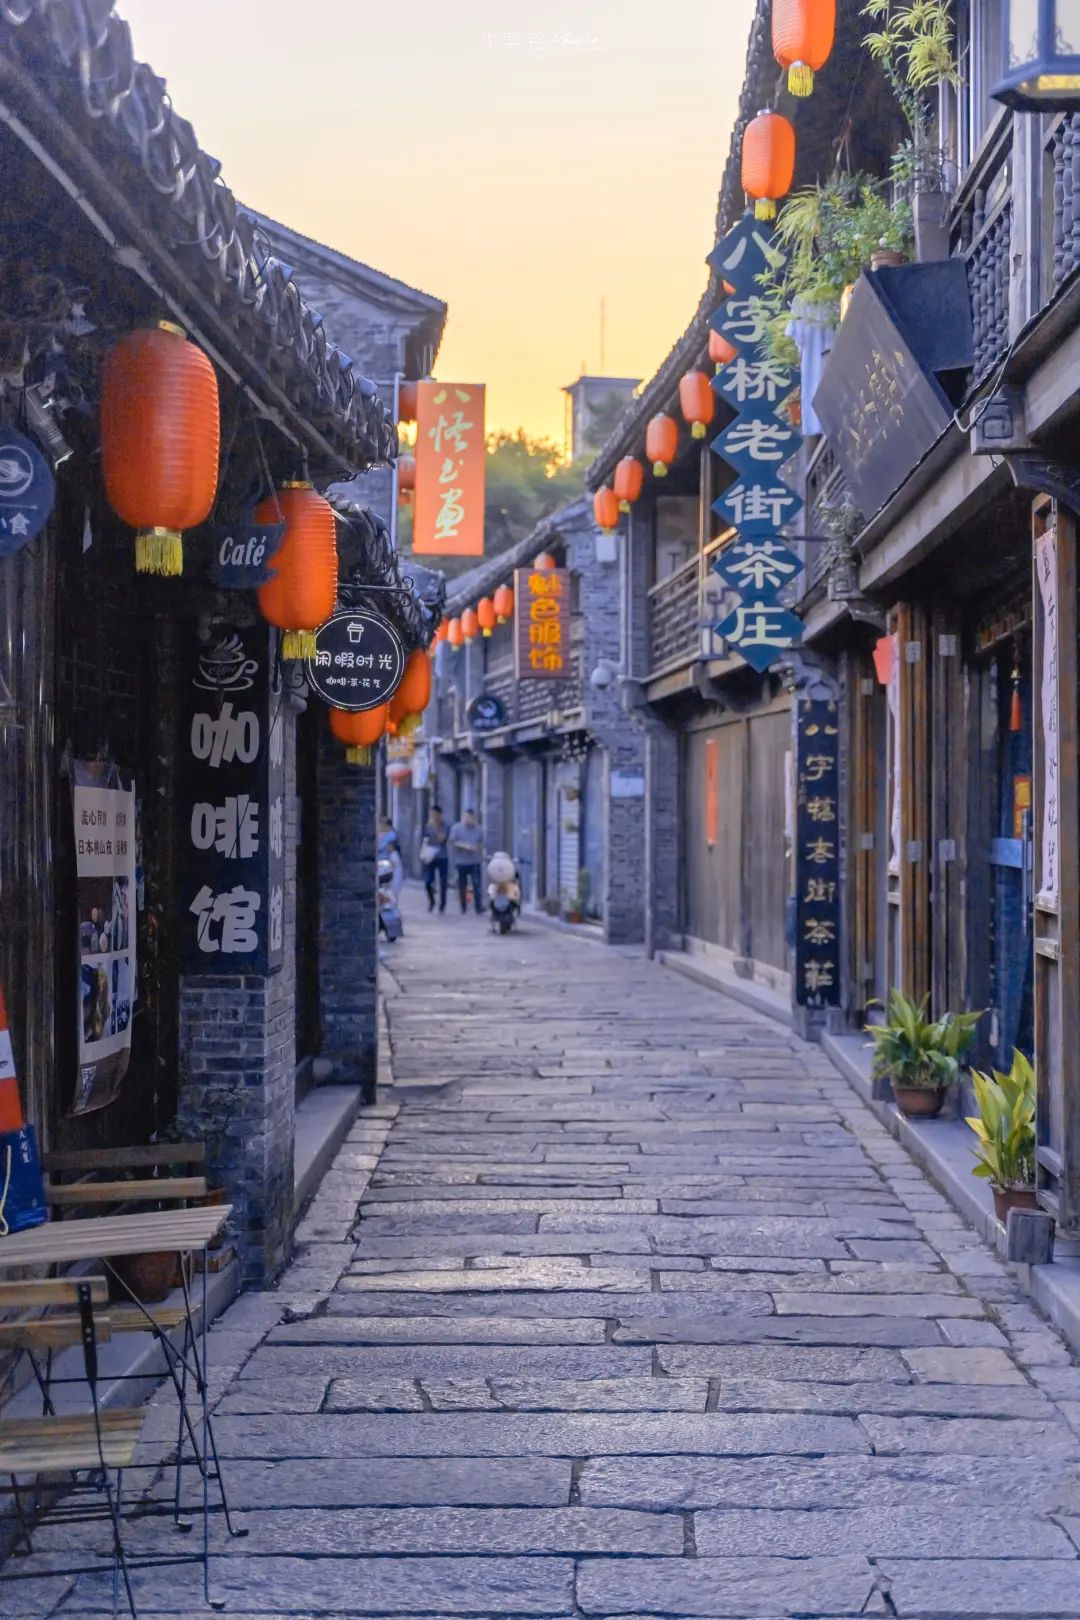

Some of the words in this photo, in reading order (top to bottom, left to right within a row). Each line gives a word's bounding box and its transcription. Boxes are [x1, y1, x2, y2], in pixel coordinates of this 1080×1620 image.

[722, 231, 795, 648] 八字桥老街茶庄
[219, 536, 267, 567] Café
[315, 650, 393, 670] 闲暇时光
[189, 702, 262, 954] 咖啡馆
